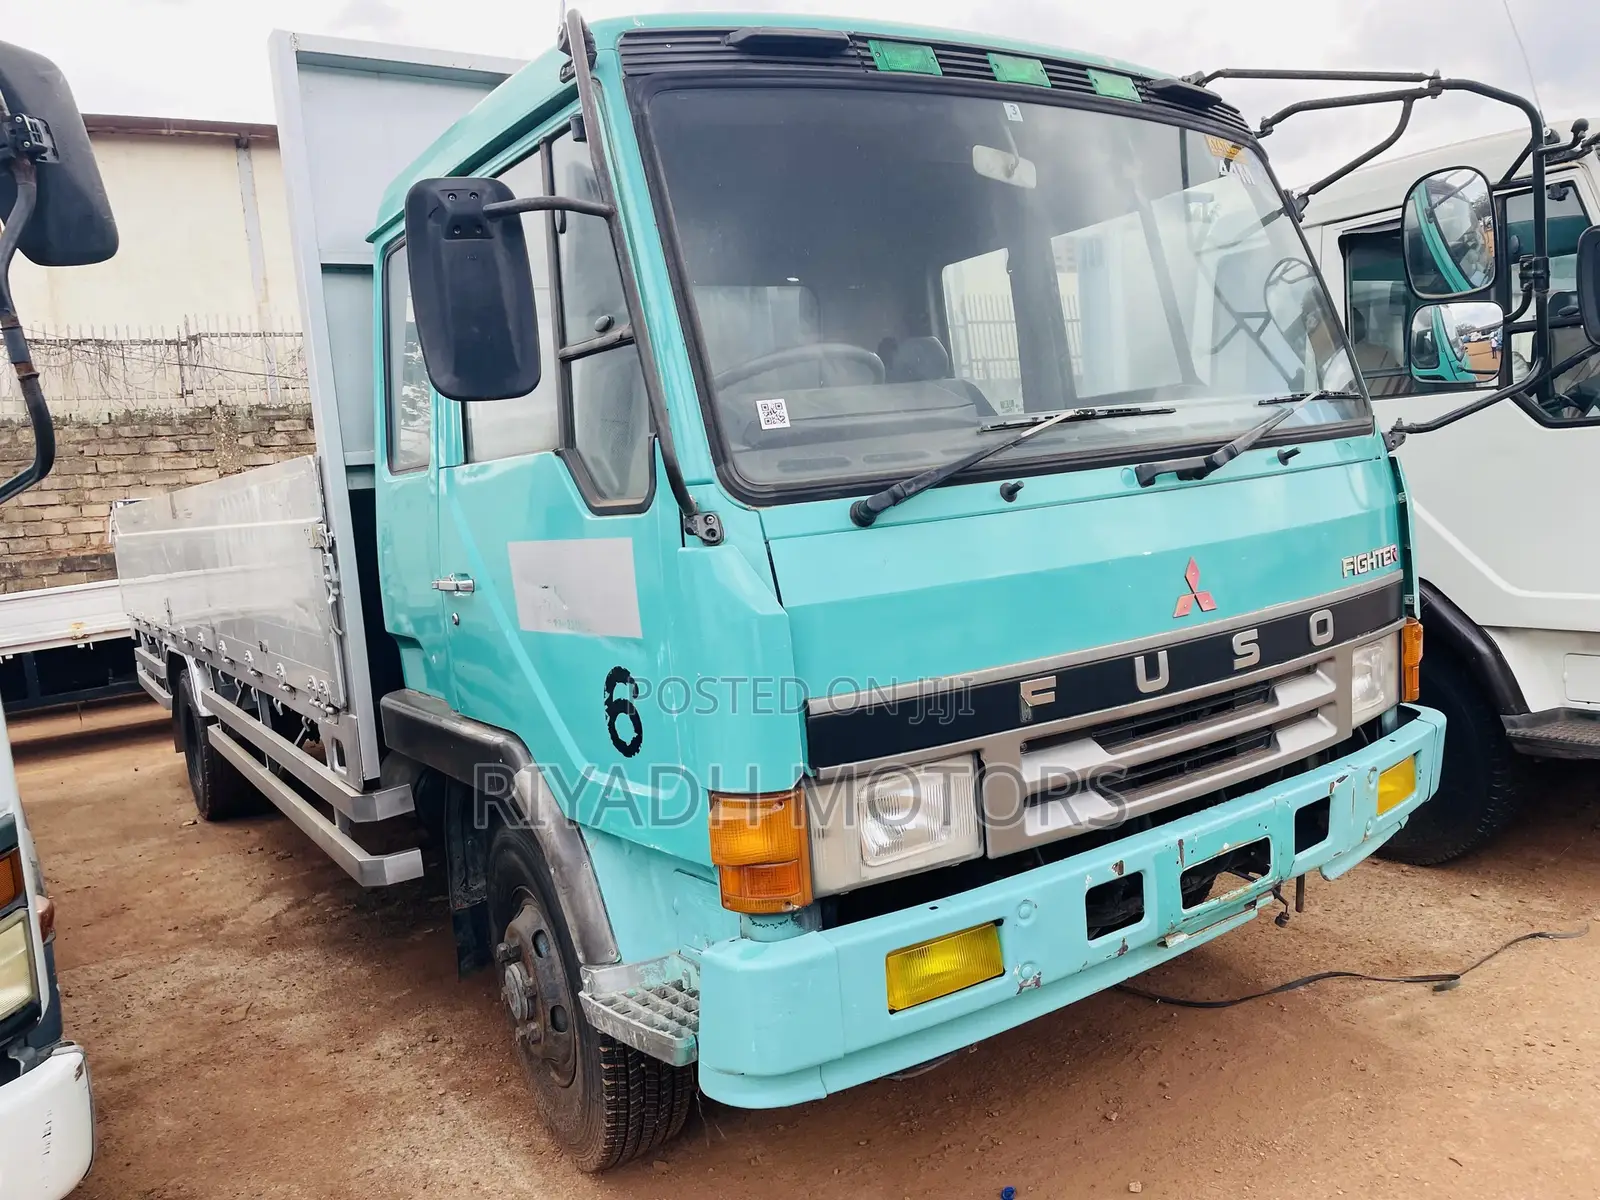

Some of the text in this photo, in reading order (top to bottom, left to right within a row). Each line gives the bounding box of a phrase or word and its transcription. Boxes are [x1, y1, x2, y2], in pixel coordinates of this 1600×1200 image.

[1342, 544, 1398, 578] FIGHTER
[603, 665, 643, 758] 6
[1020, 609, 1335, 722] FUSO
